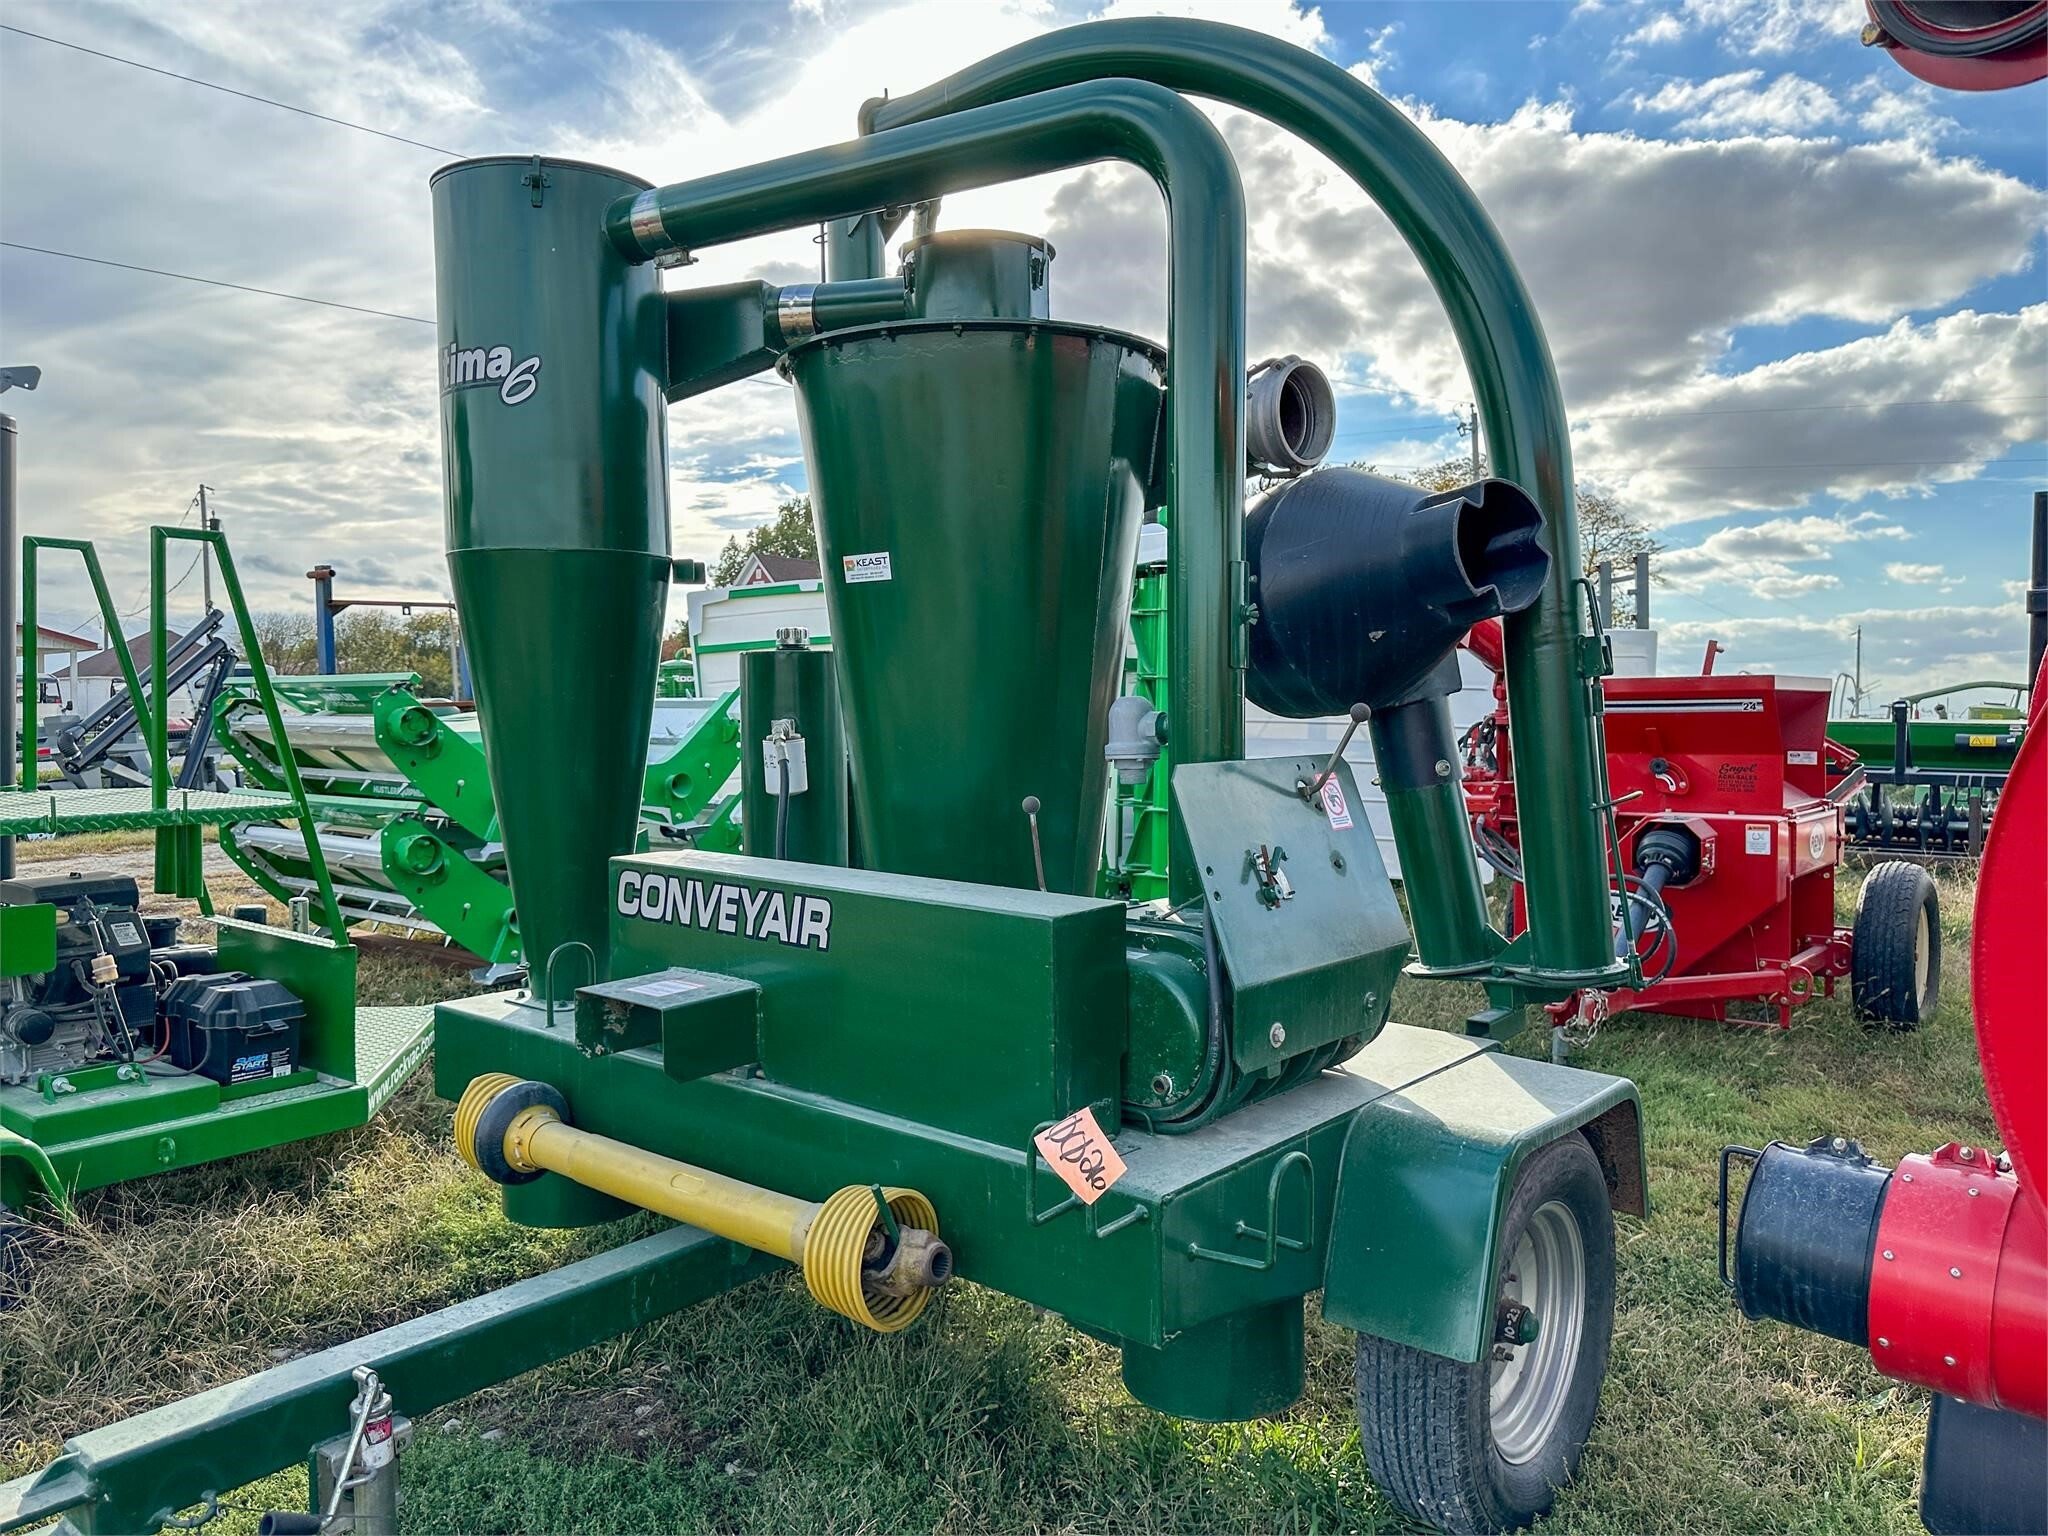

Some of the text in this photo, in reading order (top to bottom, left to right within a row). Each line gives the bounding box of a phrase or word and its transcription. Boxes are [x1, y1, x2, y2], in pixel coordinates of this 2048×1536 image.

[856, 556, 888, 567] KEAST
[1743, 702, 1757, 711] 24
[1719, 762, 1758, 774] Engel
[617, 869, 833, 951] CONVEYAIR
[236, 1053, 269, 1063] SUPER
